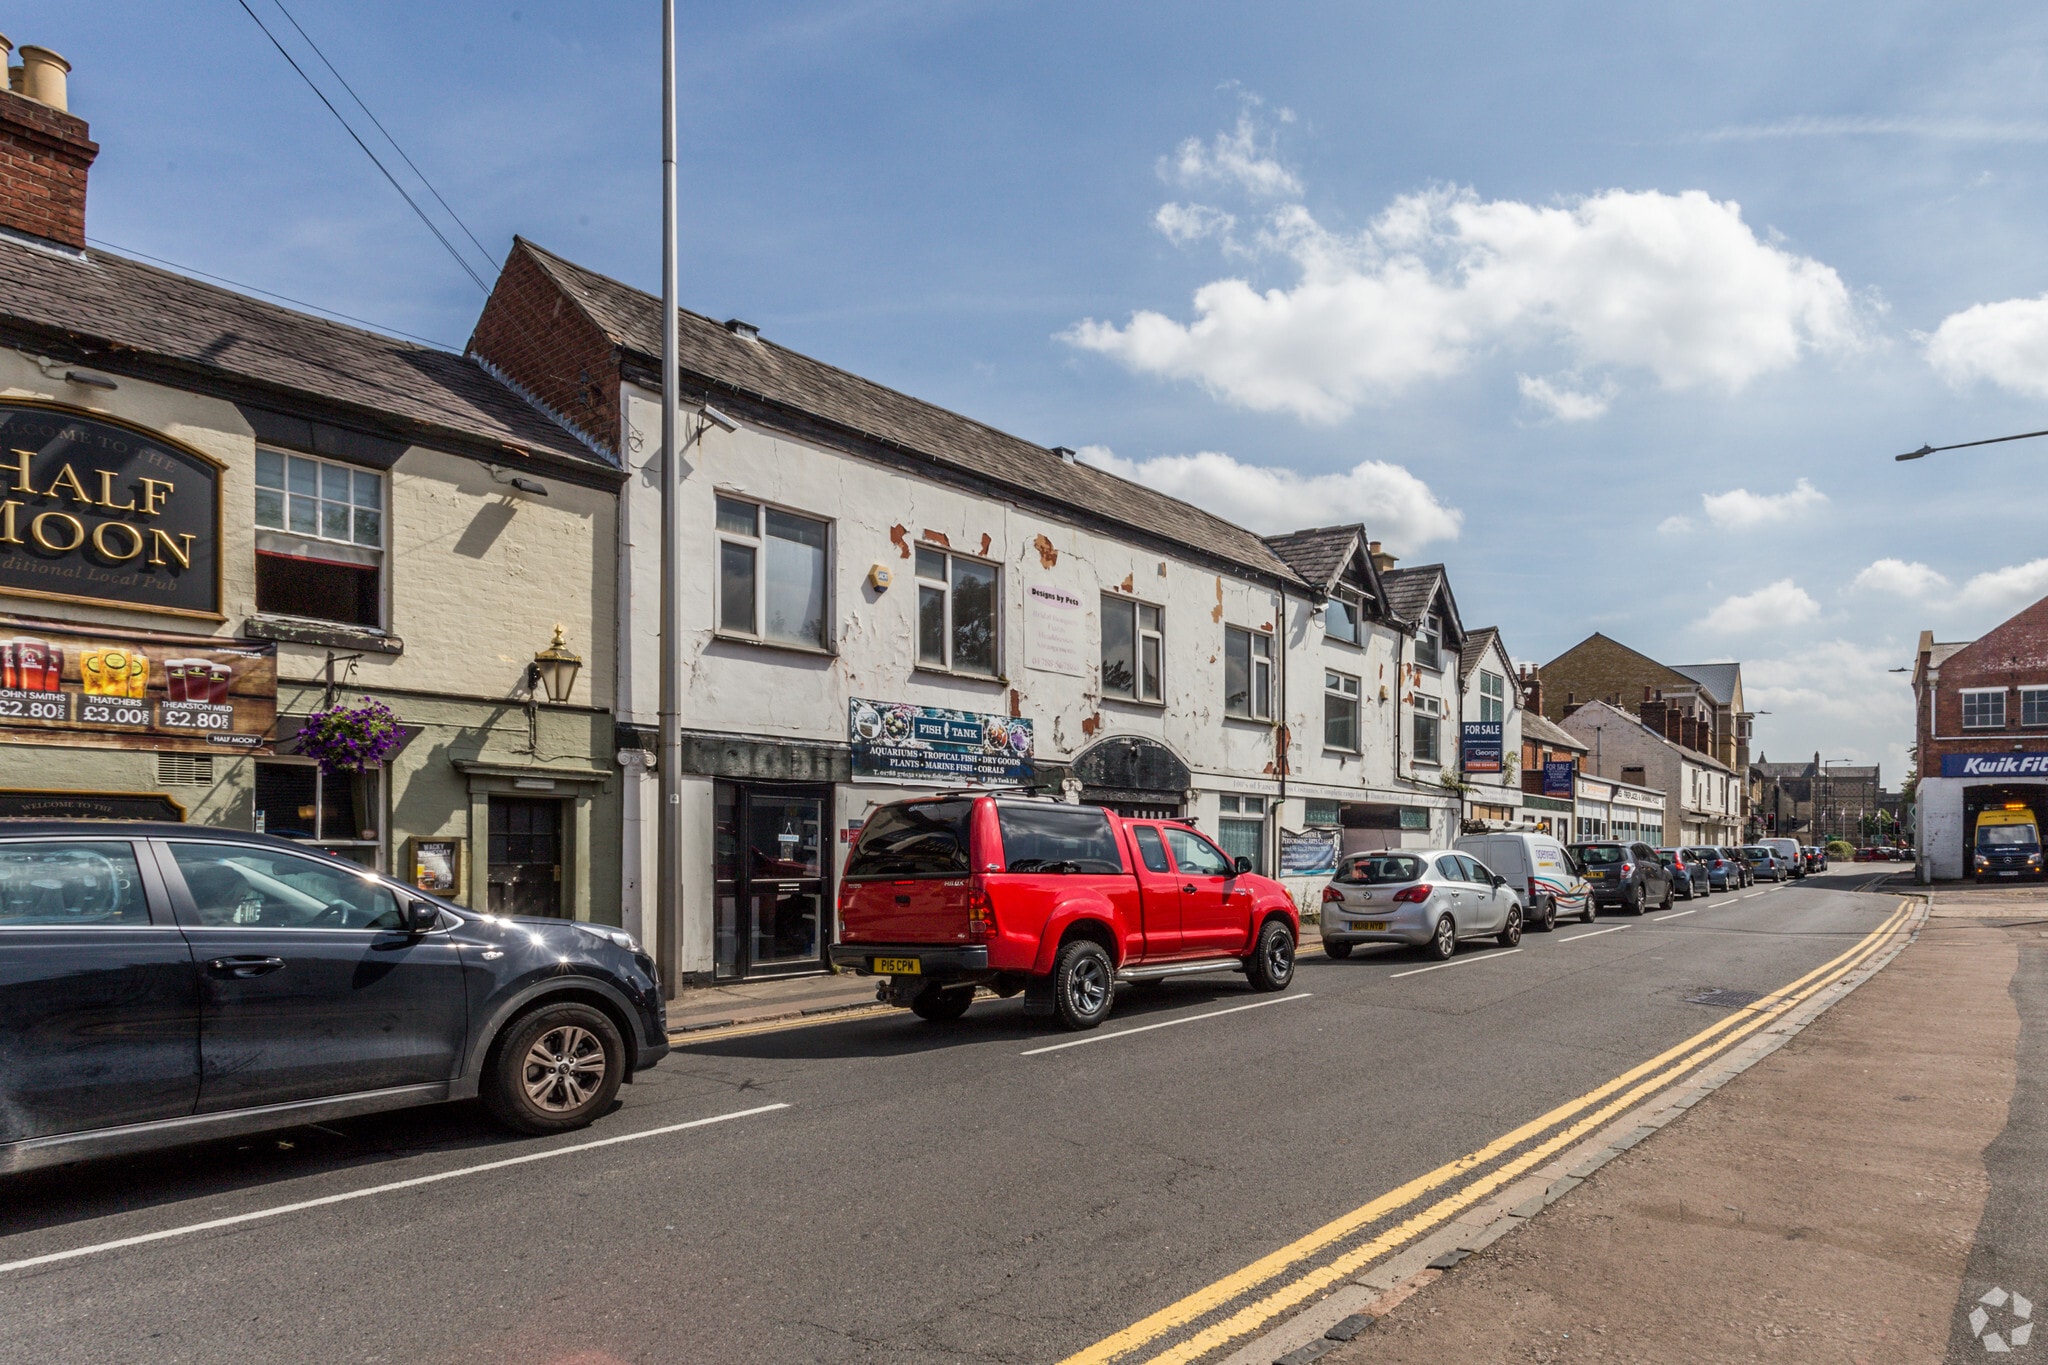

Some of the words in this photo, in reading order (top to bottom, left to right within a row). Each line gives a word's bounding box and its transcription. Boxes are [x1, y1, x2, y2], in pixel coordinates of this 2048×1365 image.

[98, 436, 128, 451] TO
[137, 449, 177, 473] THE
[88, 568, 138, 586] Local
[143, 576, 178, 593] Pub
[1031, 588, 1056, 600] Designs
[1056, 595, 1065, 603] by
[0, 688, 27, 699] OHN
[29, 691, 66, 702] SMITHS
[88, 695, 143, 707] THATCHERS
[0, 700, 57, 719] £2.80
[161, 700, 212, 711] THEAKSTON
[213, 703, 233, 713] MILD
[83, 706, 141, 724] £3.00
[165, 710, 222, 728] £2.80
[919, 724, 942, 735] FISH
[951, 728, 978, 739] TANK
[1464, 724, 1481, 735] FOR
[1481, 724, 1500, 735] SALE
[213, 735, 231, 743] HALF
[231, 736, 257, 744] MOON
[869, 746, 918, 757] AQUARIUMS
[923, 751, 960, 762] TROPICAL
[961, 754, 978, 763] FISH
[982, 756, 997, 765] DRY
[997, 757, 1021, 766] GOODS
[1475, 749, 1499, 757] George
[890, 758, 920, 768] PLANTS
[925, 761, 955, 771] MARINE
[956, 763, 973, 773] FISH
[978, 765, 1005, 775] CORALS
[1546, 763, 1556, 771] FOR
[1557, 763, 1570, 771] SALE
[1963, 757, 2019, 775] Kwik
[2018, 756, 2048, 773] Fit
[21, 801, 74, 811] WELCOME
[77, 801, 91, 809] TO
[93, 802, 113, 813] THE
[896, 960, 914, 972] CPM
